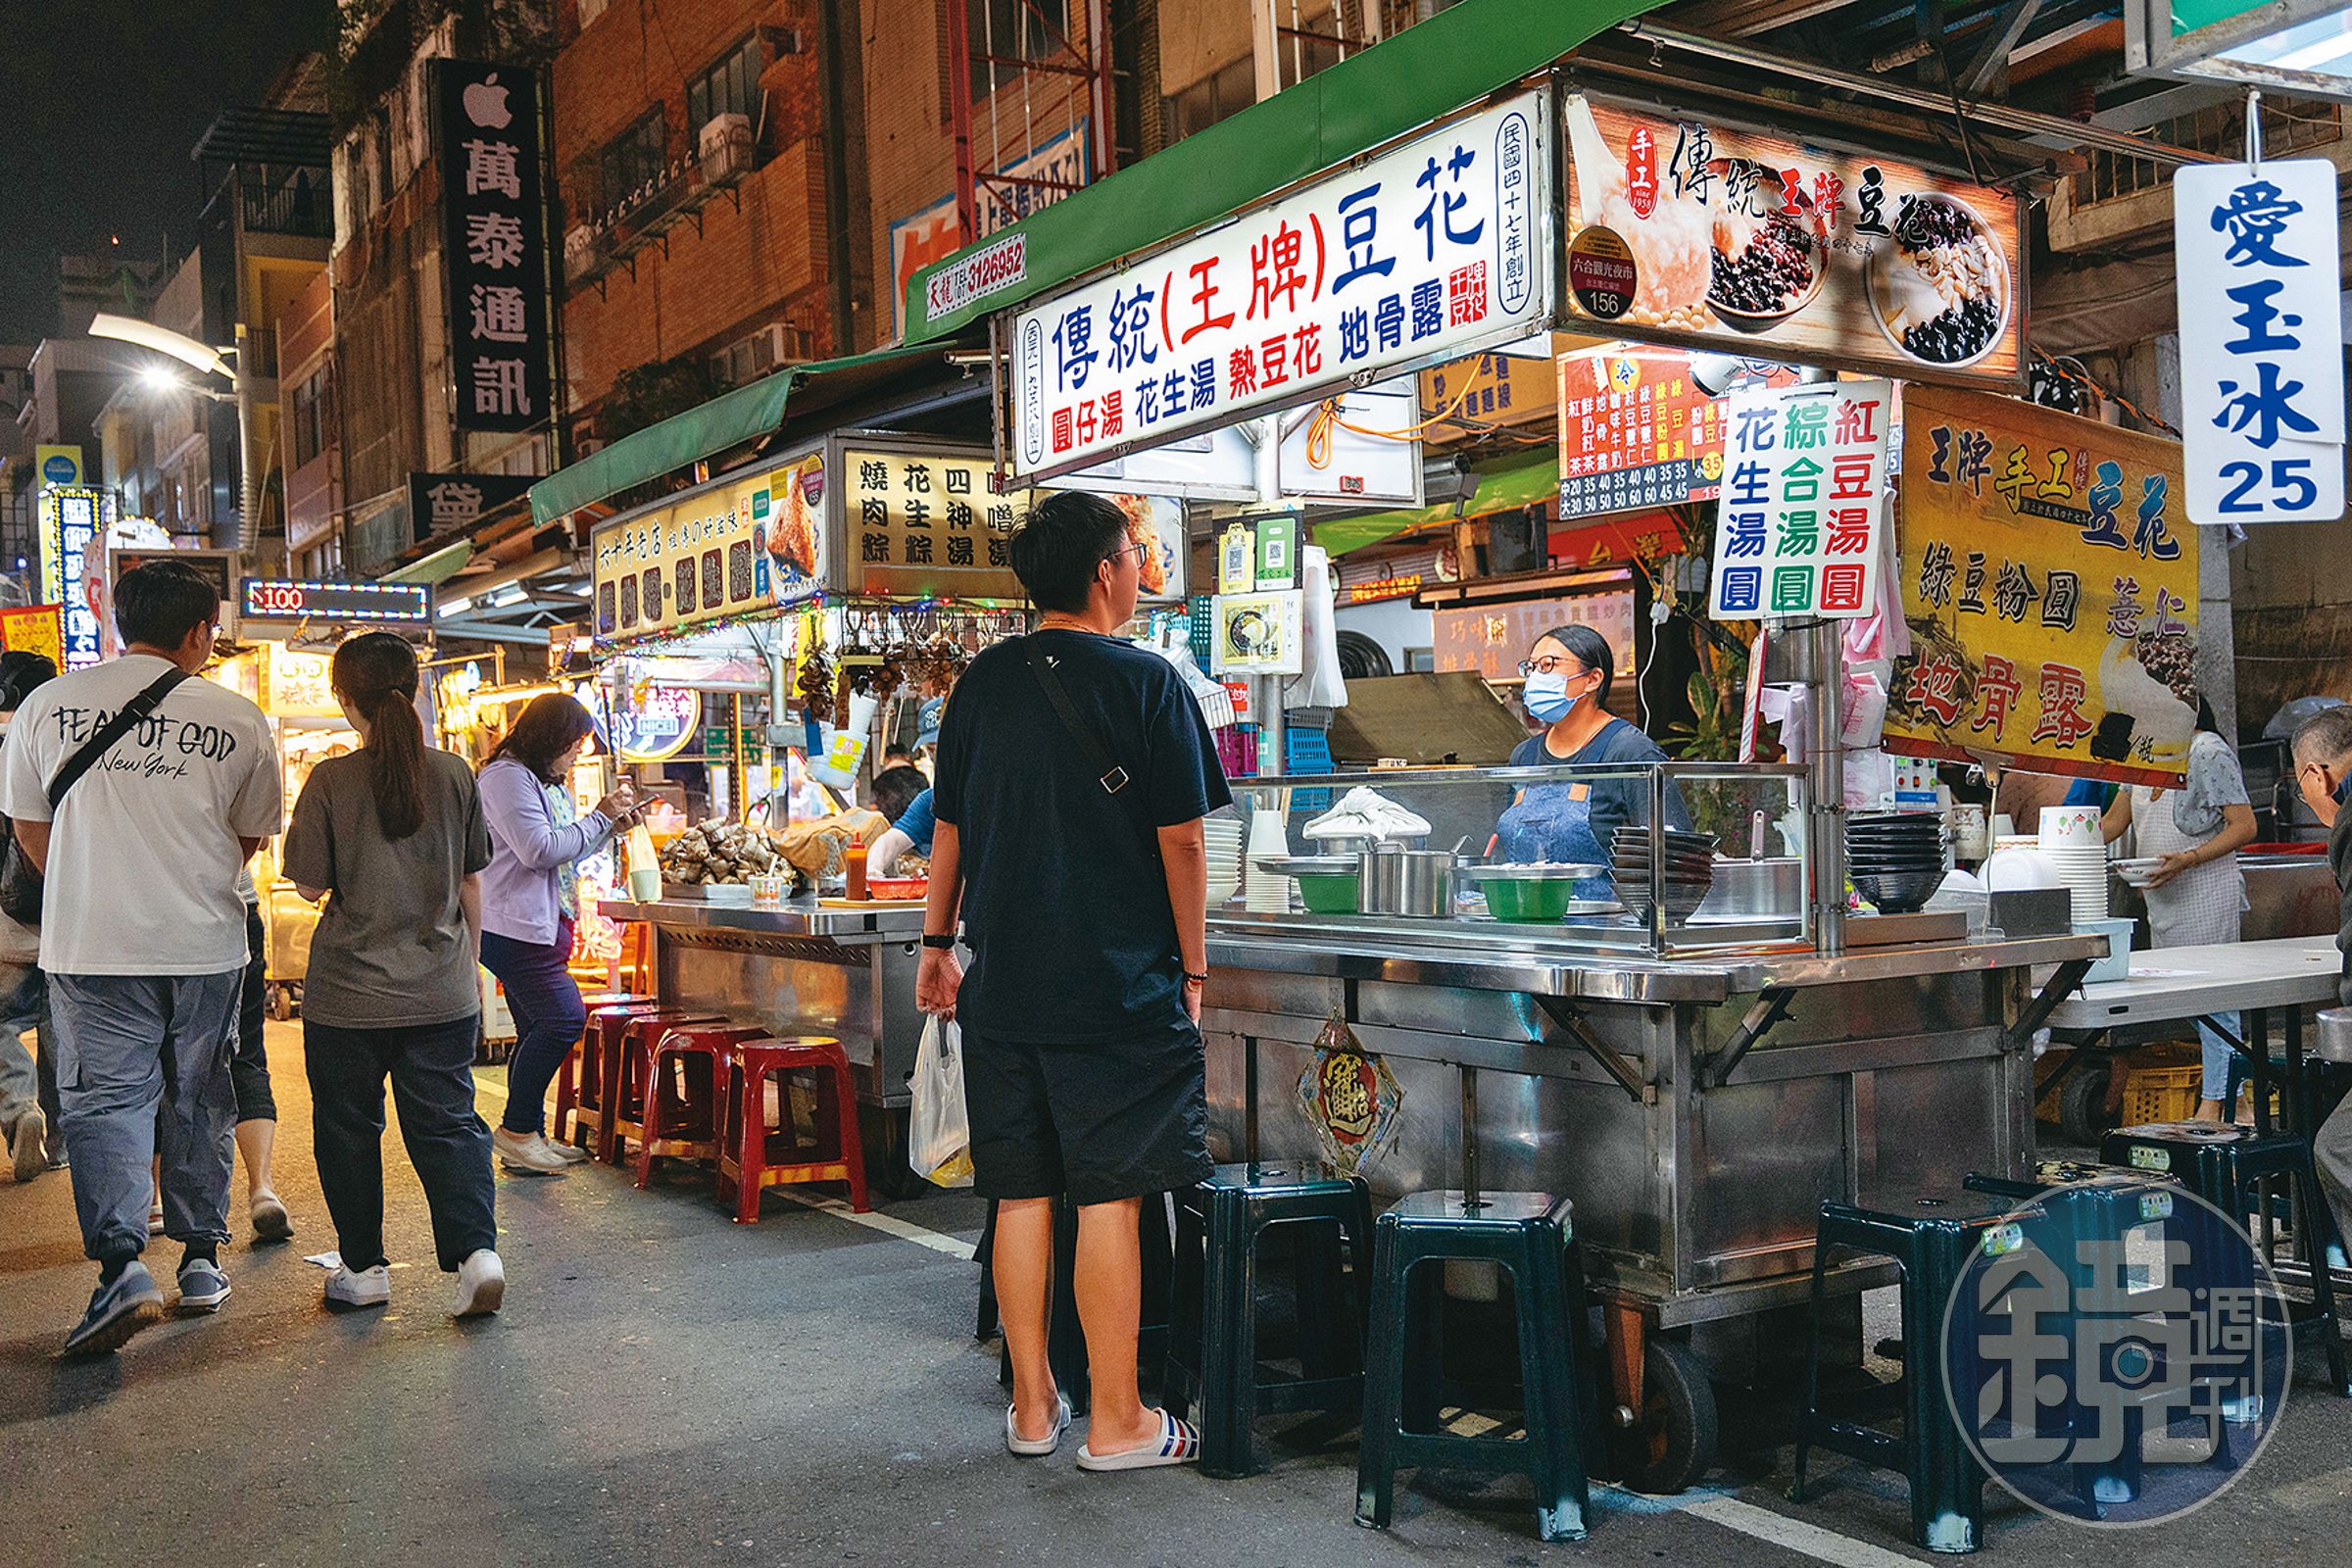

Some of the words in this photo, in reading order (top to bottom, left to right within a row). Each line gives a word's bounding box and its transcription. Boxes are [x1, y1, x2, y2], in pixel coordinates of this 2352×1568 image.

[1631, 129, 1652, 188] 手工
[1503, 122, 1524, 302] 民國四十七年創立
[462, 139, 530, 417] 萬泰通訊
[955, 268, 967, 285] TEL
[967, 242, 1022, 293] 3126952
[1052, 145, 1486, 392] 傳統(王牌)豆花
[1573, 258, 1633, 280] 六合觀光夜市
[1590, 292, 1619, 314] 156
[2210, 180, 2320, 449] 愛玉冰
[1052, 389, 1124, 454] 圓仔湯
[1135, 358, 1215, 428] 花生湯
[1229, 323, 1322, 400] 熱豆花
[1338, 277, 1444, 365] 地骨露
[1616, 360, 1636, 385] 冷
[1581, 397, 1594, 472] 鮮奶紅茶
[1584, 477, 1595, 492] 35
[1598, 474, 1611, 490] 40
[1614, 472, 1626, 488] 35
[1629, 469, 1642, 486] 40
[1643, 467, 1656, 483] 40
[1659, 465, 1672, 480] 35
[1675, 462, 1687, 478] 35
[1704, 457, 1721, 471] 35
[859, 461, 890, 564] 燒肉粽
[904, 465, 933, 564] 花生粽
[945, 468, 974, 566] 四神湯
[1585, 496, 1596, 512] 50
[1599, 493, 1611, 510] 50
[1614, 491, 1626, 508] 50
[1629, 488, 1642, 505] 60
[1644, 487, 1656, 503] 60
[1659, 484, 1672, 501] 45
[1675, 481, 1688, 498] 45
[1720, 407, 1777, 612] 花生湯圓
[1770, 402, 1829, 612] 綜合湯圓
[1820, 399, 1881, 610] 紅豆湯圓
[2219, 460, 2318, 514] 25
[1918, 541, 2081, 629] 綠豆粉圓
[2106, 576, 2188, 639] 薏仁
[52, 697, 133, 745] FEA
[138, 714, 179, 750] OF
[176, 722, 236, 762] GOD
[1906, 647, 2094, 747] 地骨露
[97, 749, 142, 772] New
[140, 752, 189, 780] York
